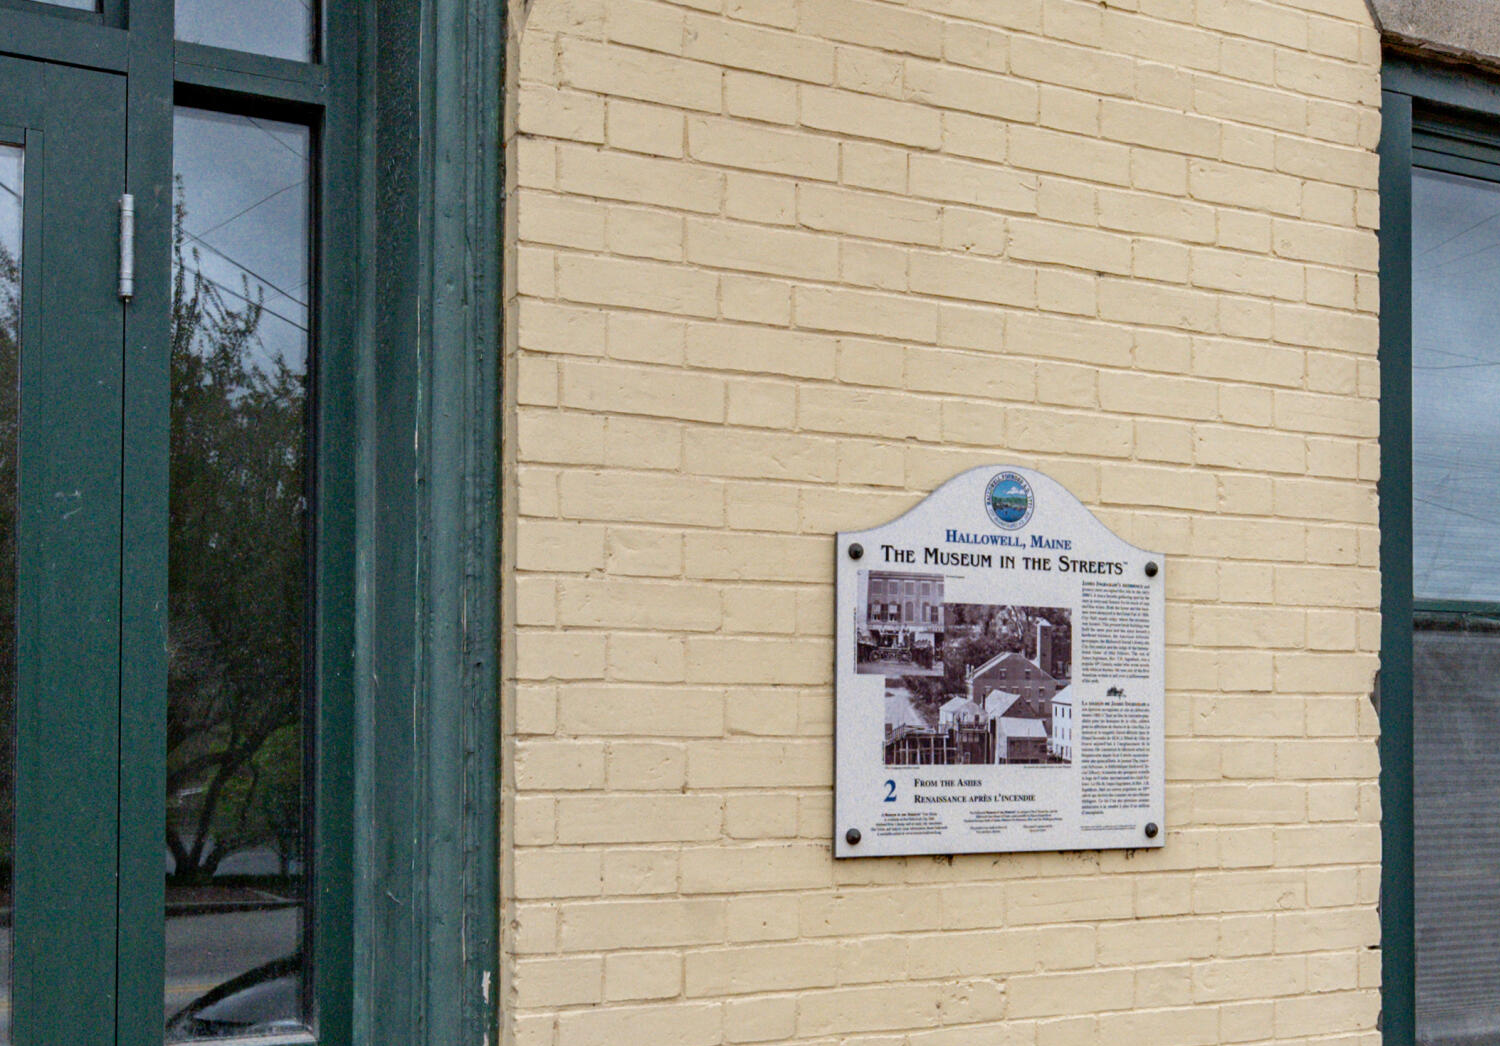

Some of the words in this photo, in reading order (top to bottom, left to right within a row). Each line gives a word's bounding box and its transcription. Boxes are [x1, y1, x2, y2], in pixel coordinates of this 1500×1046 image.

[945, 529, 1026, 549] HALLOWELL,
[1031, 534, 1072, 550] MAINE
[881, 544, 916, 564] THE
[924, 547, 992, 568] MUSEUM
[1000, 555, 1015, 569] IN
[1022, 556, 1051, 572] THE
[883, 779, 897, 803] 2
[914, 778, 938, 788] FROM
[941, 779, 955, 788] THE
[957, 778, 982, 788] ASHES
[914, 794, 967, 804] RENAISSANCE
[969, 793, 992, 803] APRÈS
